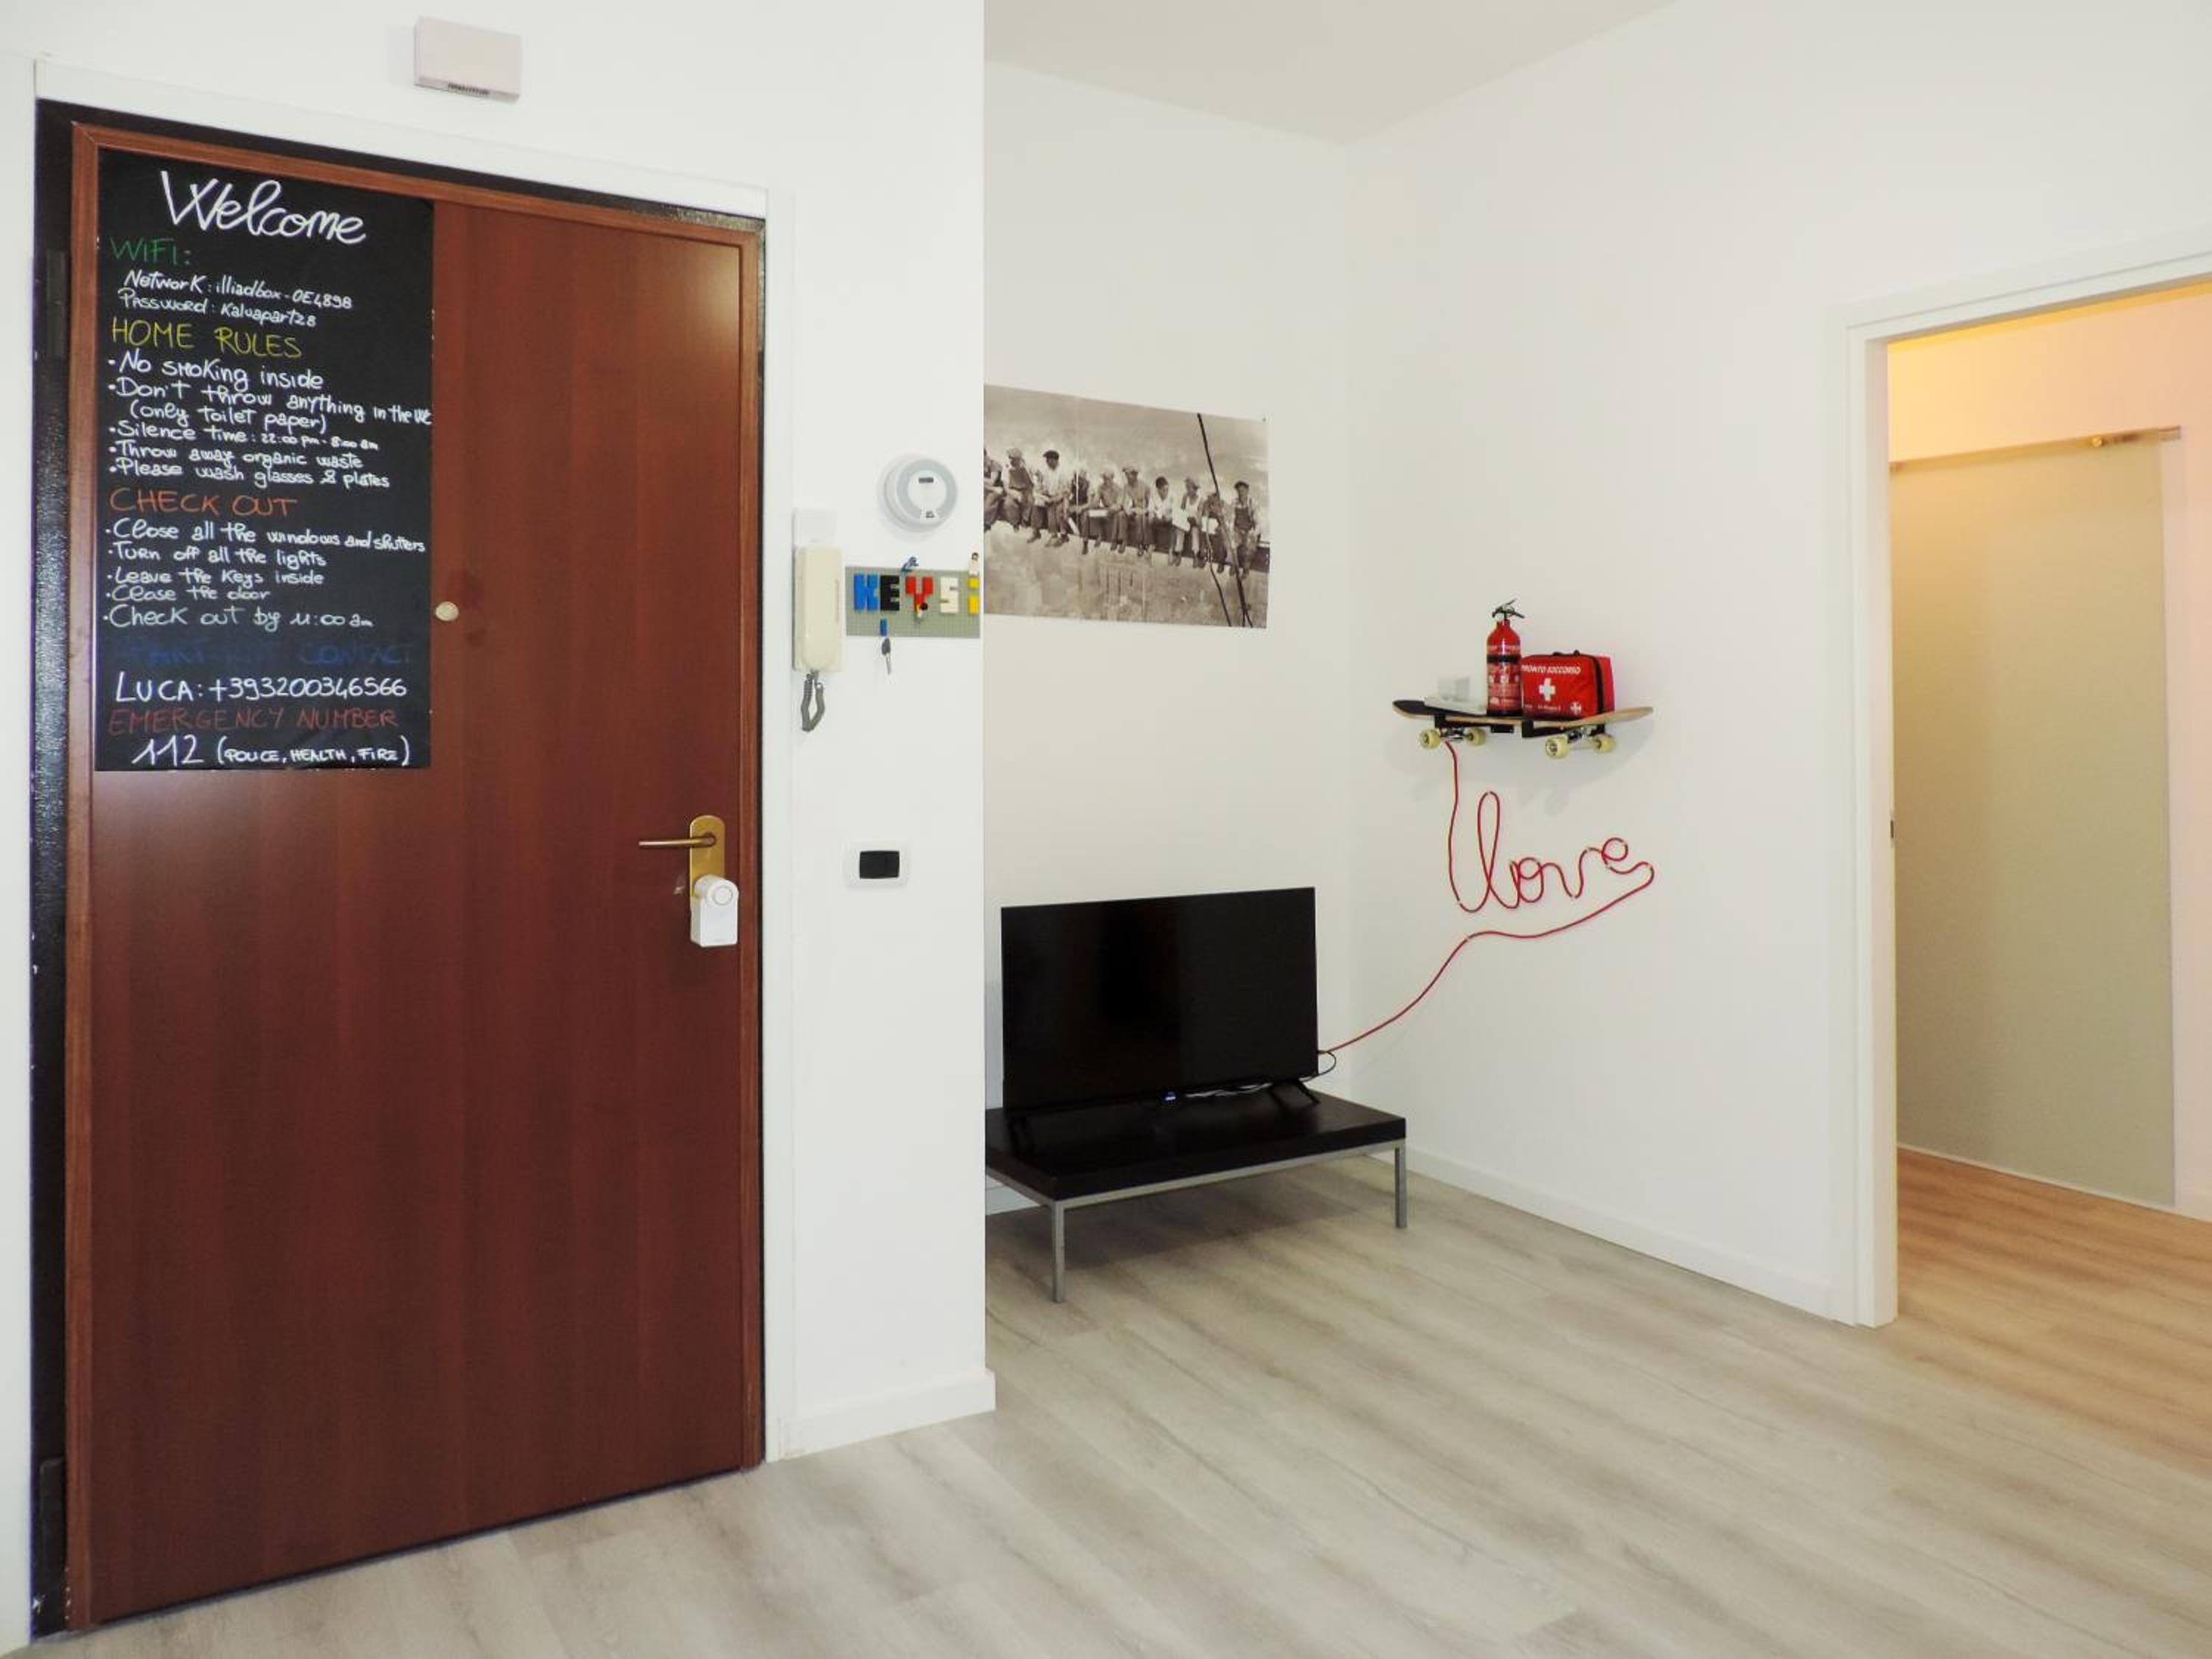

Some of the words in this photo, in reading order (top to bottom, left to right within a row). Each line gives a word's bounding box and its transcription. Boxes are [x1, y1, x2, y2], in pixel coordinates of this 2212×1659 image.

[161, 170, 366, 244] Welcome
[112, 317, 195, 348] HOME
[214, 327, 302, 358] RULES
[119, 348, 151, 373] No
[260, 366, 324, 389] inside
[116, 376, 191, 399] Don't
[201, 384, 272, 405] throw
[286, 394, 365, 423] anything
[387, 404, 412, 424] the
[117, 420, 197, 441] Silence
[197, 406, 257, 425] toilet
[264, 414, 327, 435] paper)
[115, 439, 177, 458] Throw
[189, 448, 235, 469] away
[243, 452, 307, 468] organic
[316, 453, 364, 468] waste
[115, 457, 184, 476] Please
[195, 466, 245, 480] wash
[254, 467, 314, 488] glasses
[342, 472, 390, 490] plates
[111, 487, 220, 515] CHECK
[232, 495, 299, 516] OUT
[113, 518, 180, 539] Close
[191, 521, 215, 541] all
[220, 522, 257, 543] the
[266, 528, 341, 546] windows
[344, 530, 372, 548] and
[372, 534, 425, 553] shutters
[173, 546, 201, 561] off
[208, 546, 230, 563] all
[234, 547, 267, 564] the
[276, 549, 327, 570] lights
[115, 566, 173, 584] Leave
[178, 567, 212, 584] the
[186, 585, 218, 600] the
[226, 586, 271, 600] door
[200, 605, 246, 625] out
[253, 605, 281, 632] by
[108, 706, 285, 735] EMERGENCY
[131, 734, 204, 766] 112
[1454, 790, 1643, 913] love
